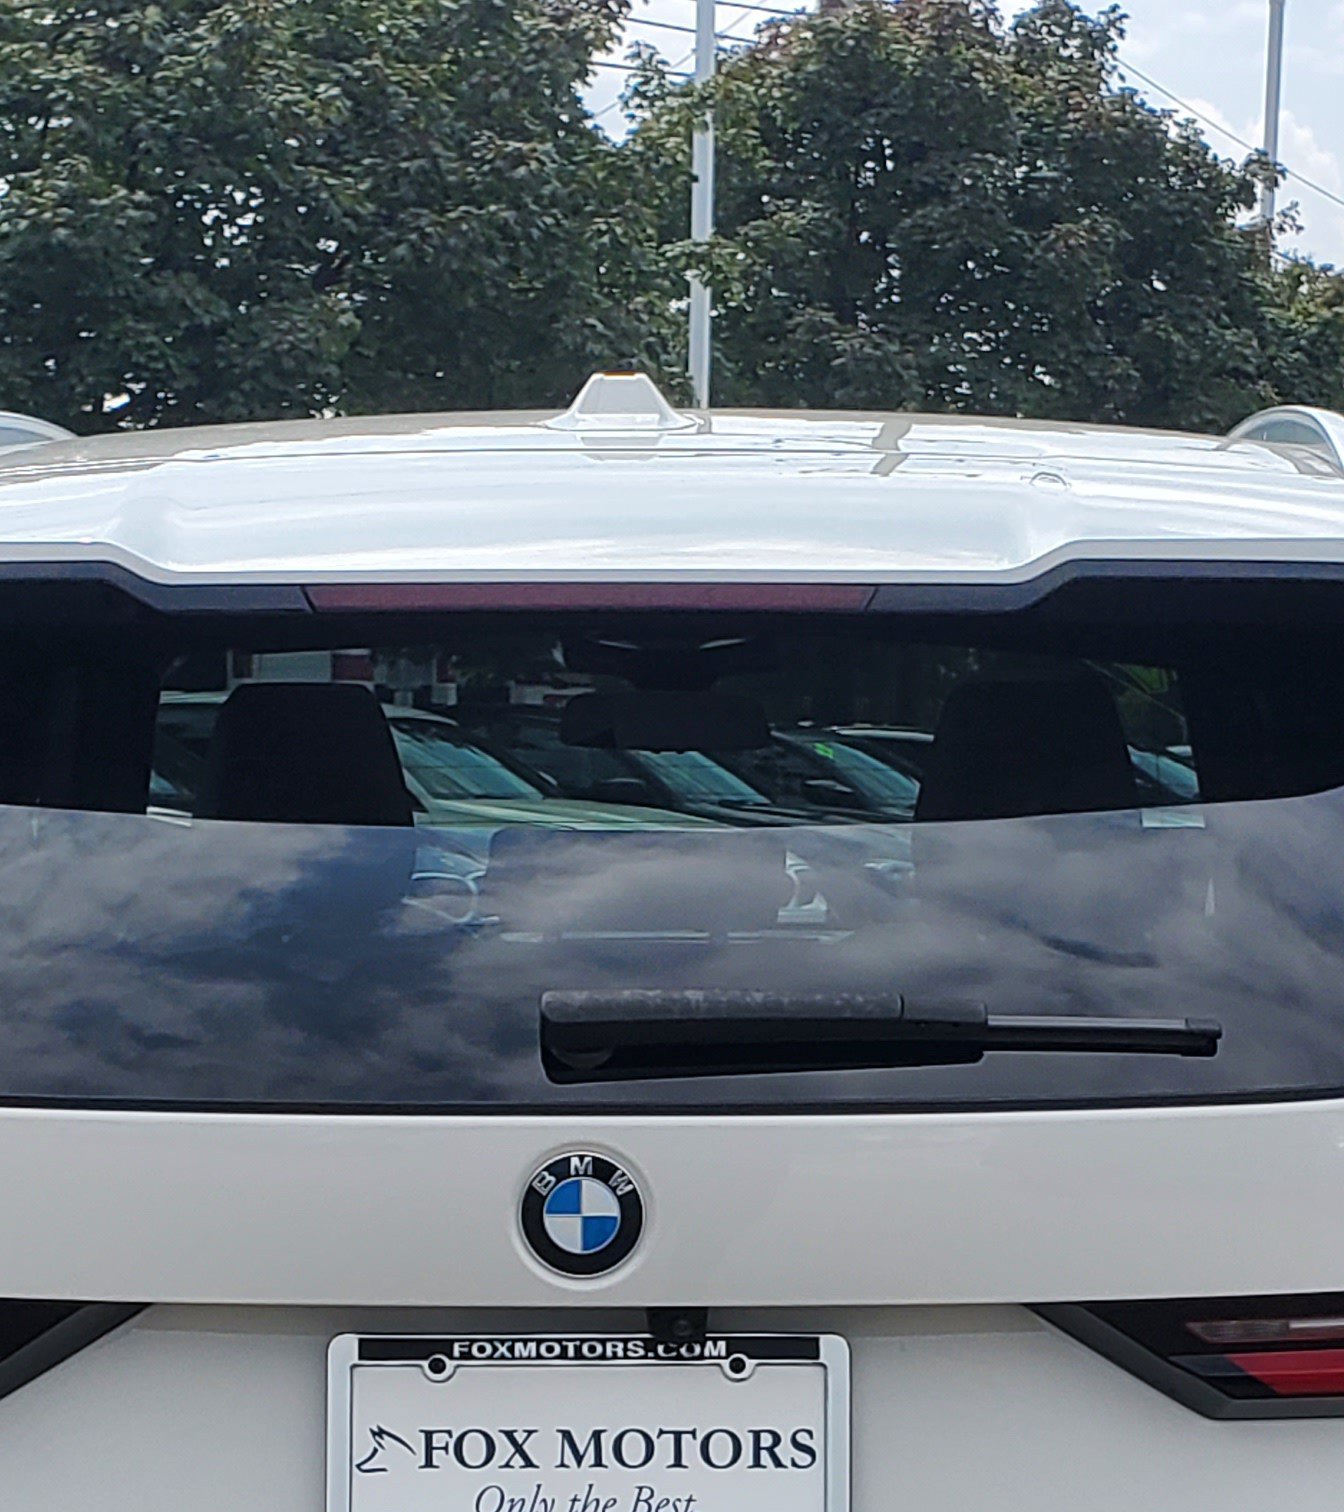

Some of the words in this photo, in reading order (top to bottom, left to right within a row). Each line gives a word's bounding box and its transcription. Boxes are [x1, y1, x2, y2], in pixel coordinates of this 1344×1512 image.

[531, 1156, 635, 1197] BMW
[418, 1428, 541, 1470] FOX
[554, 1427, 817, 1470] MOTORS
